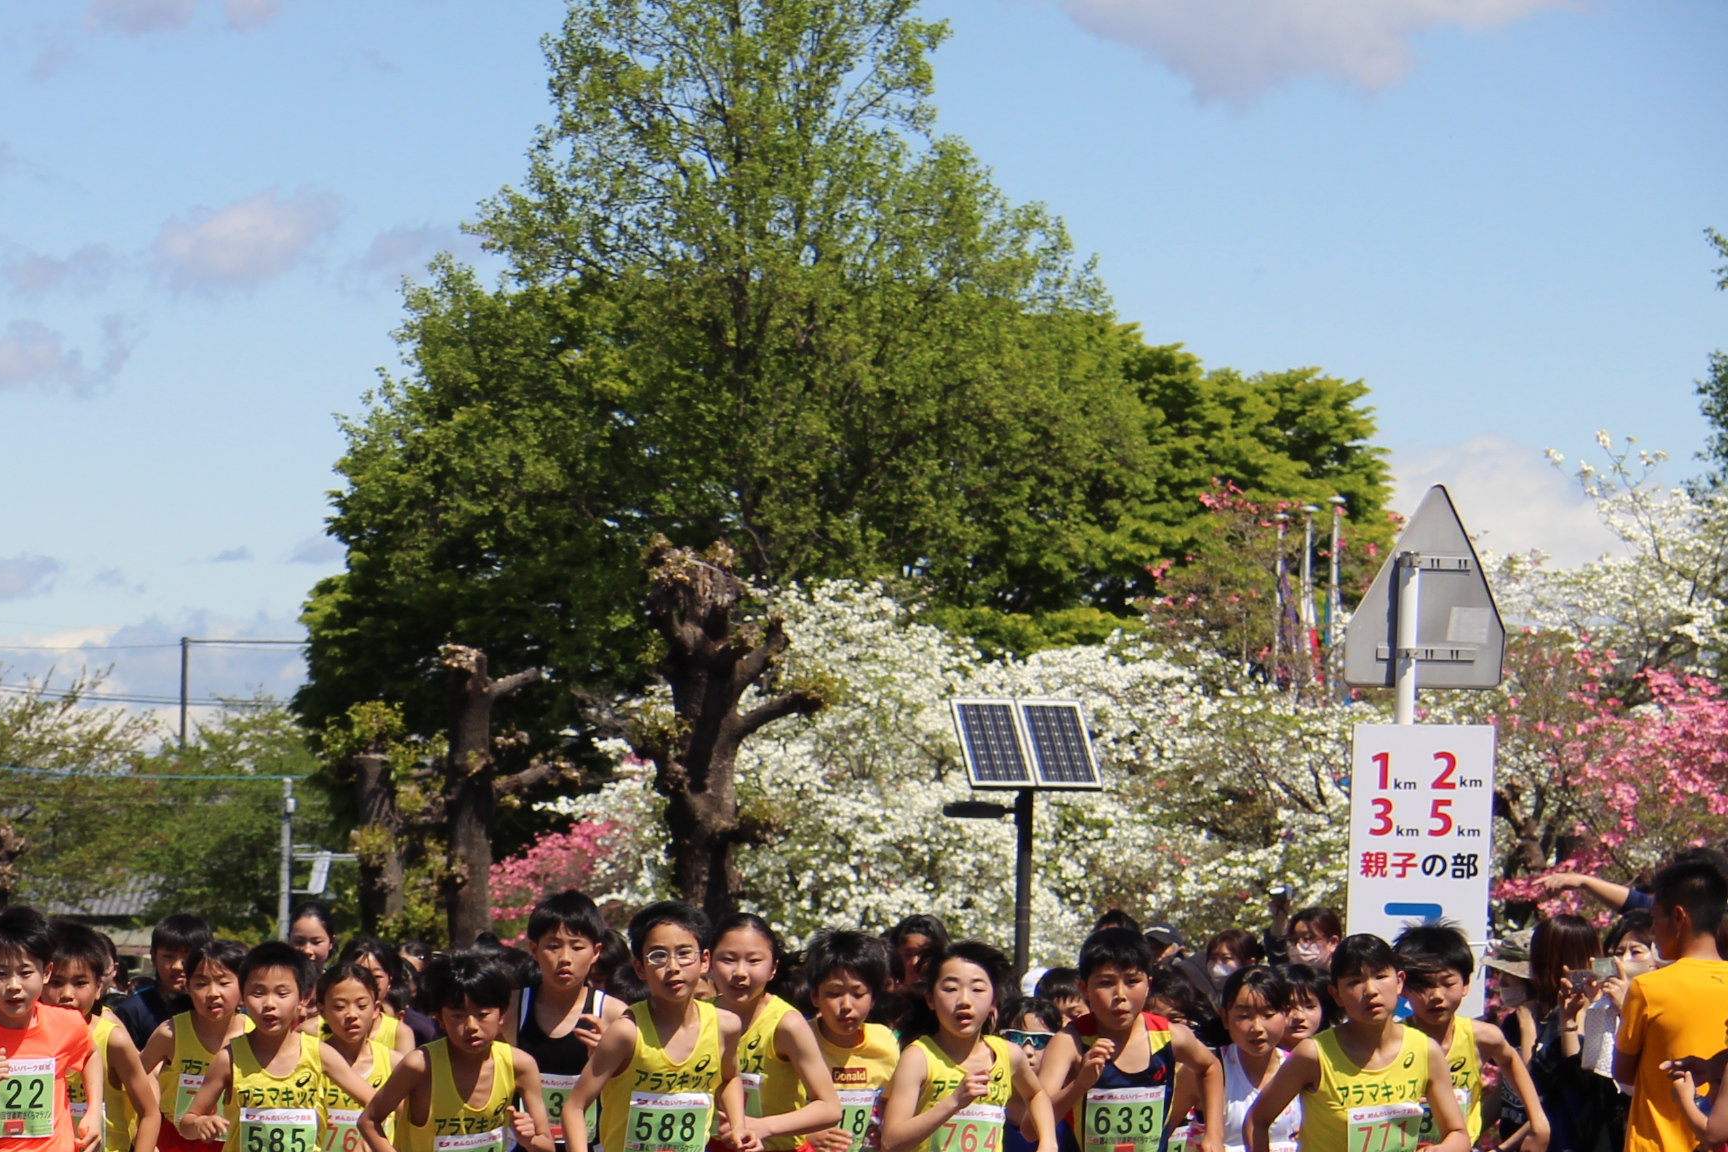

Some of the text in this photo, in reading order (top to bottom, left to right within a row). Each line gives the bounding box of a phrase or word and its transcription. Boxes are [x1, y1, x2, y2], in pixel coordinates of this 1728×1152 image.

[1360, 851, 1478, 879] 親子の部
[835, 1070, 866, 1081] Donald
[635, 1112, 696, 1142] 588
[1094, 1106, 1154, 1134] 633
